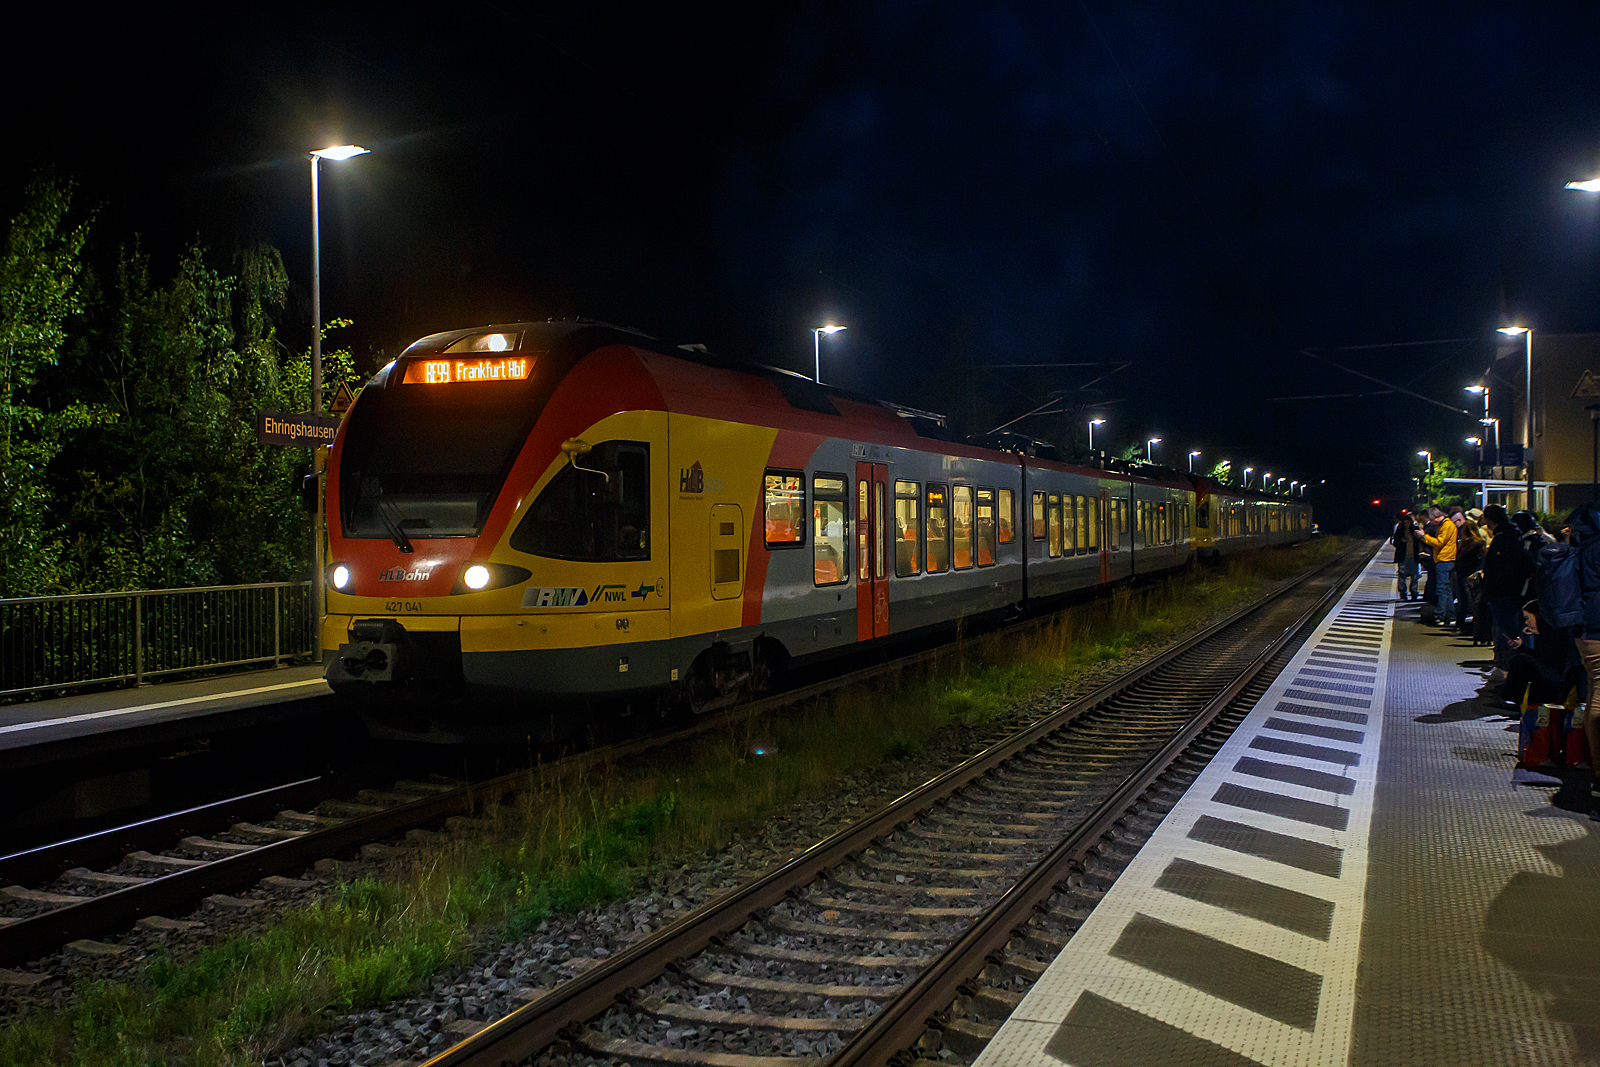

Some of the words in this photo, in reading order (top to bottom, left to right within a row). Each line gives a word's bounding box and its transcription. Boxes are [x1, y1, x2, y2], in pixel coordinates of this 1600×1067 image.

[426, 362, 449, 383] RE99
[457, 362, 505, 379] Frankfurt
[508, 361, 525, 377] Hbf
[265, 417, 334, 439] Ehringshausen
[385, 601, 402, 612] 427
[405, 601, 422, 612] 041
[537, 587, 583, 607] RMV
[604, 592, 626, 602] NWL
